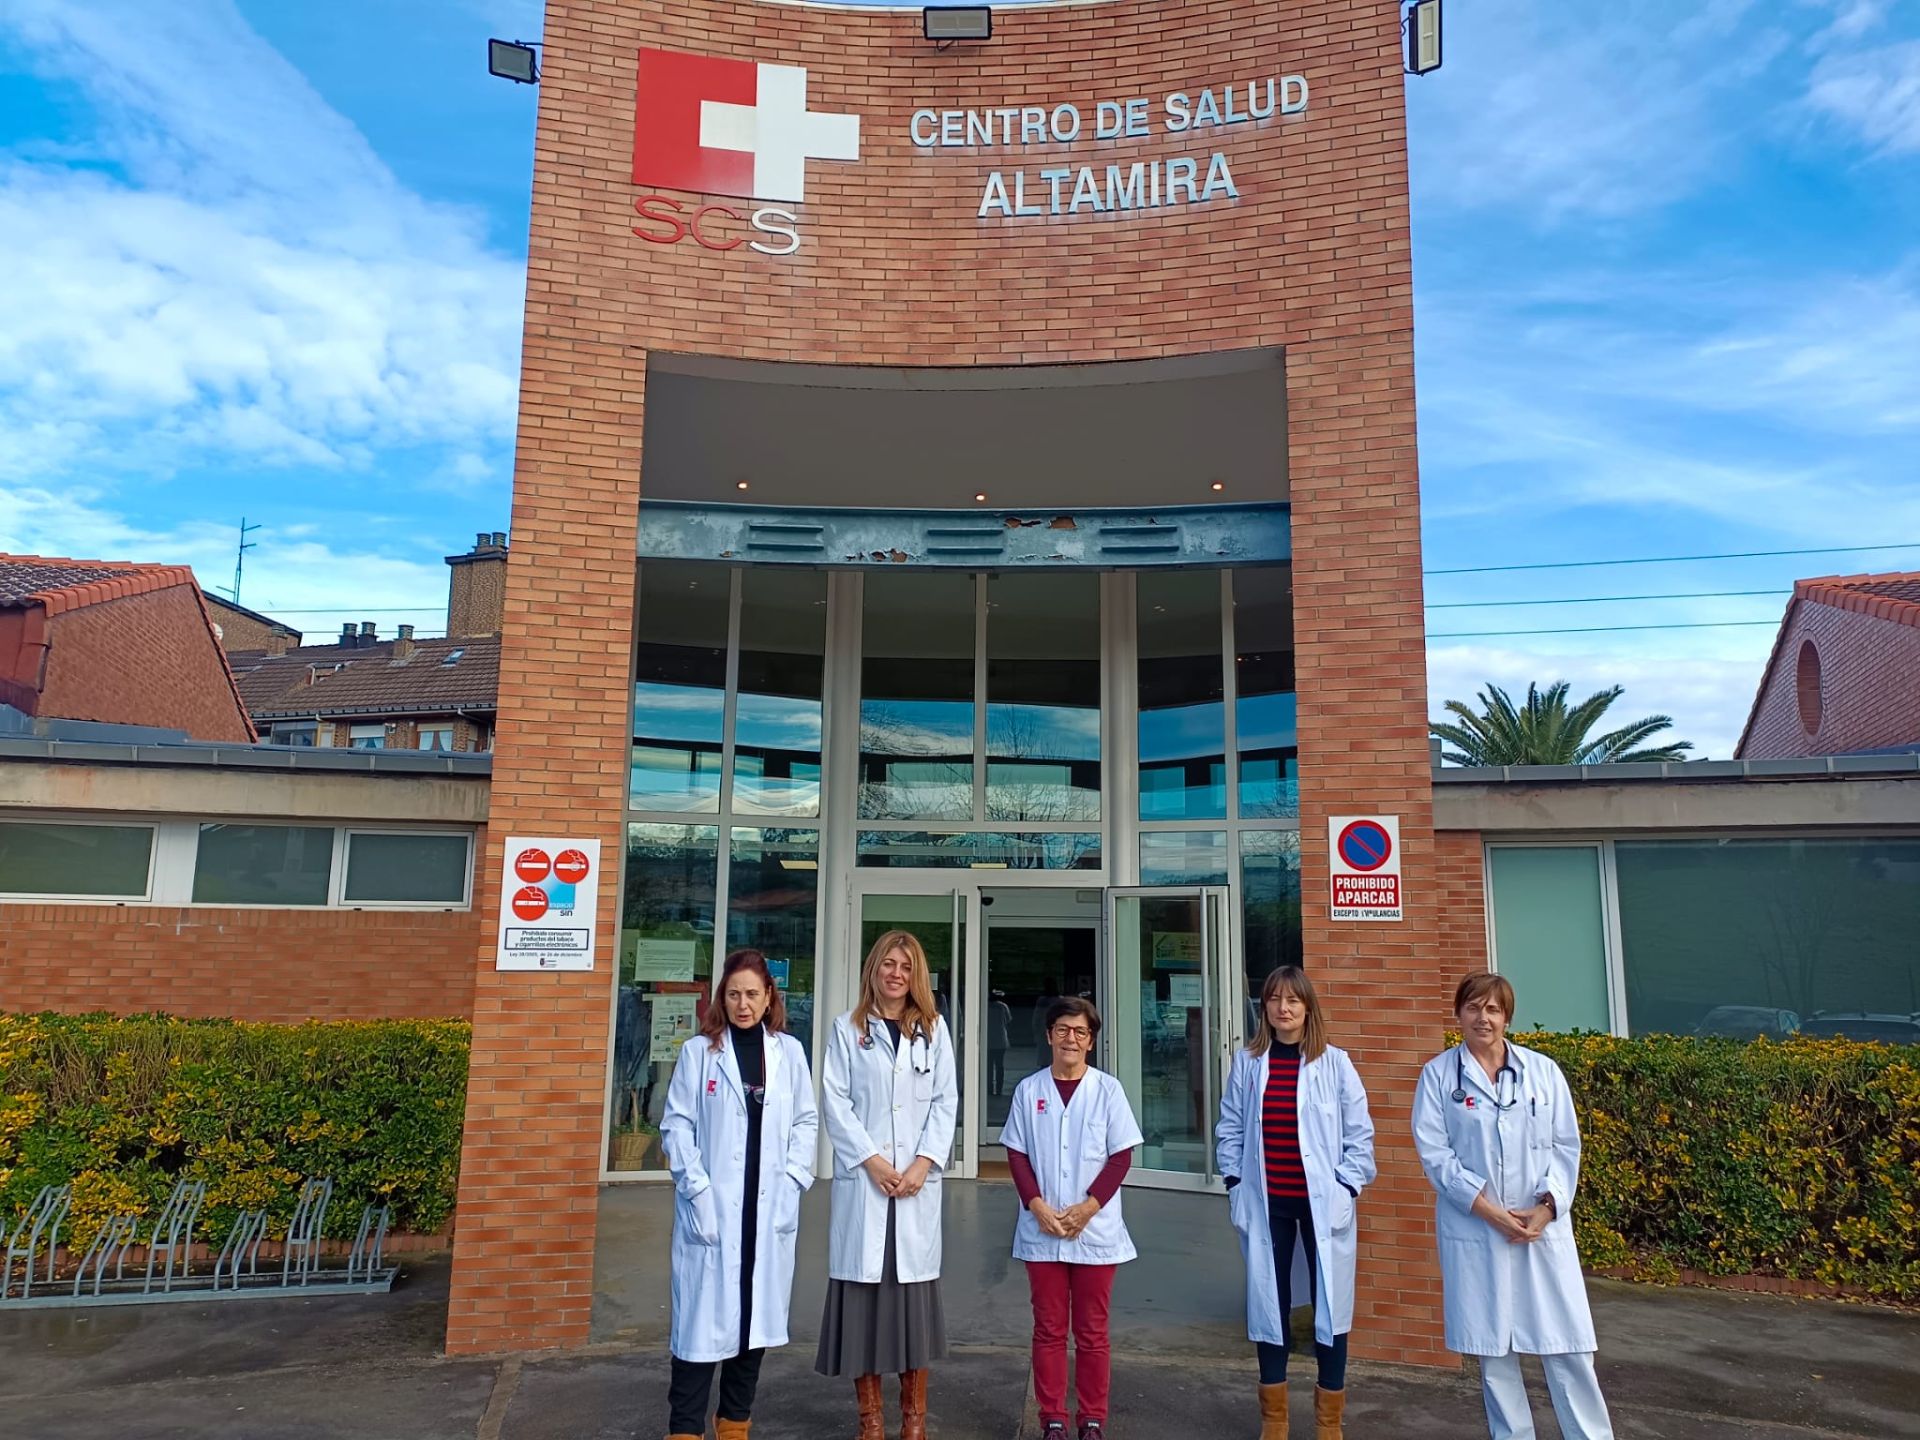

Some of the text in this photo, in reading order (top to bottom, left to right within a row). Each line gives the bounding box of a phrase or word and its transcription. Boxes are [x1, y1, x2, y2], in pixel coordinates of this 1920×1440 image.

[910, 74, 1309, 147] CENTRO DE SALUD
[977, 152, 1240, 218] ALTAMIRA
[632, 195, 800, 255] SCS
[1336, 877, 1395, 889] PROHIBIDO
[1337, 891, 1395, 905] APARCAR
[1333, 909, 1359, 917] EXCEPTO
